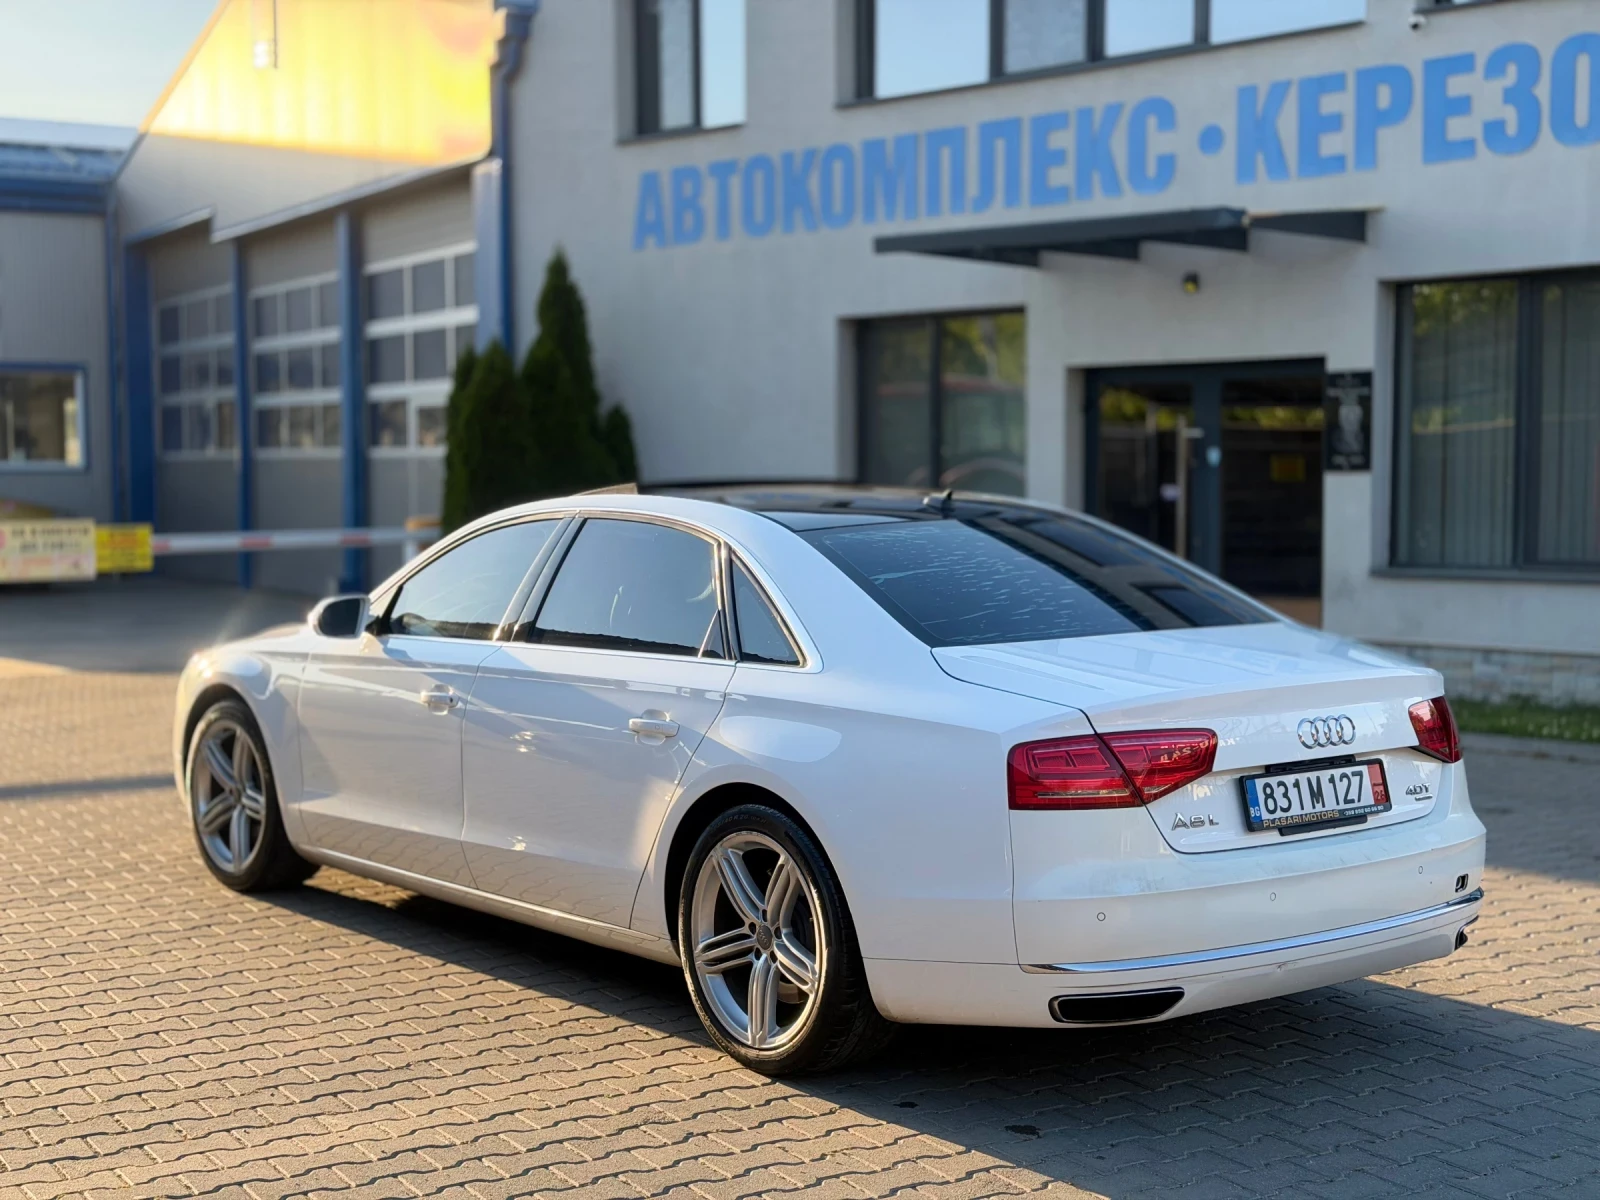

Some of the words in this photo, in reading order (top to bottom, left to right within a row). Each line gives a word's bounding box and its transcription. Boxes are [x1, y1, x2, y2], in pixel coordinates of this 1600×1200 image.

[632, 97, 1177, 250] АВТОКОМПЛЕКС
[1250, 806, 1261, 818] BG
[1302, 810, 1340, 823] MOTORS
